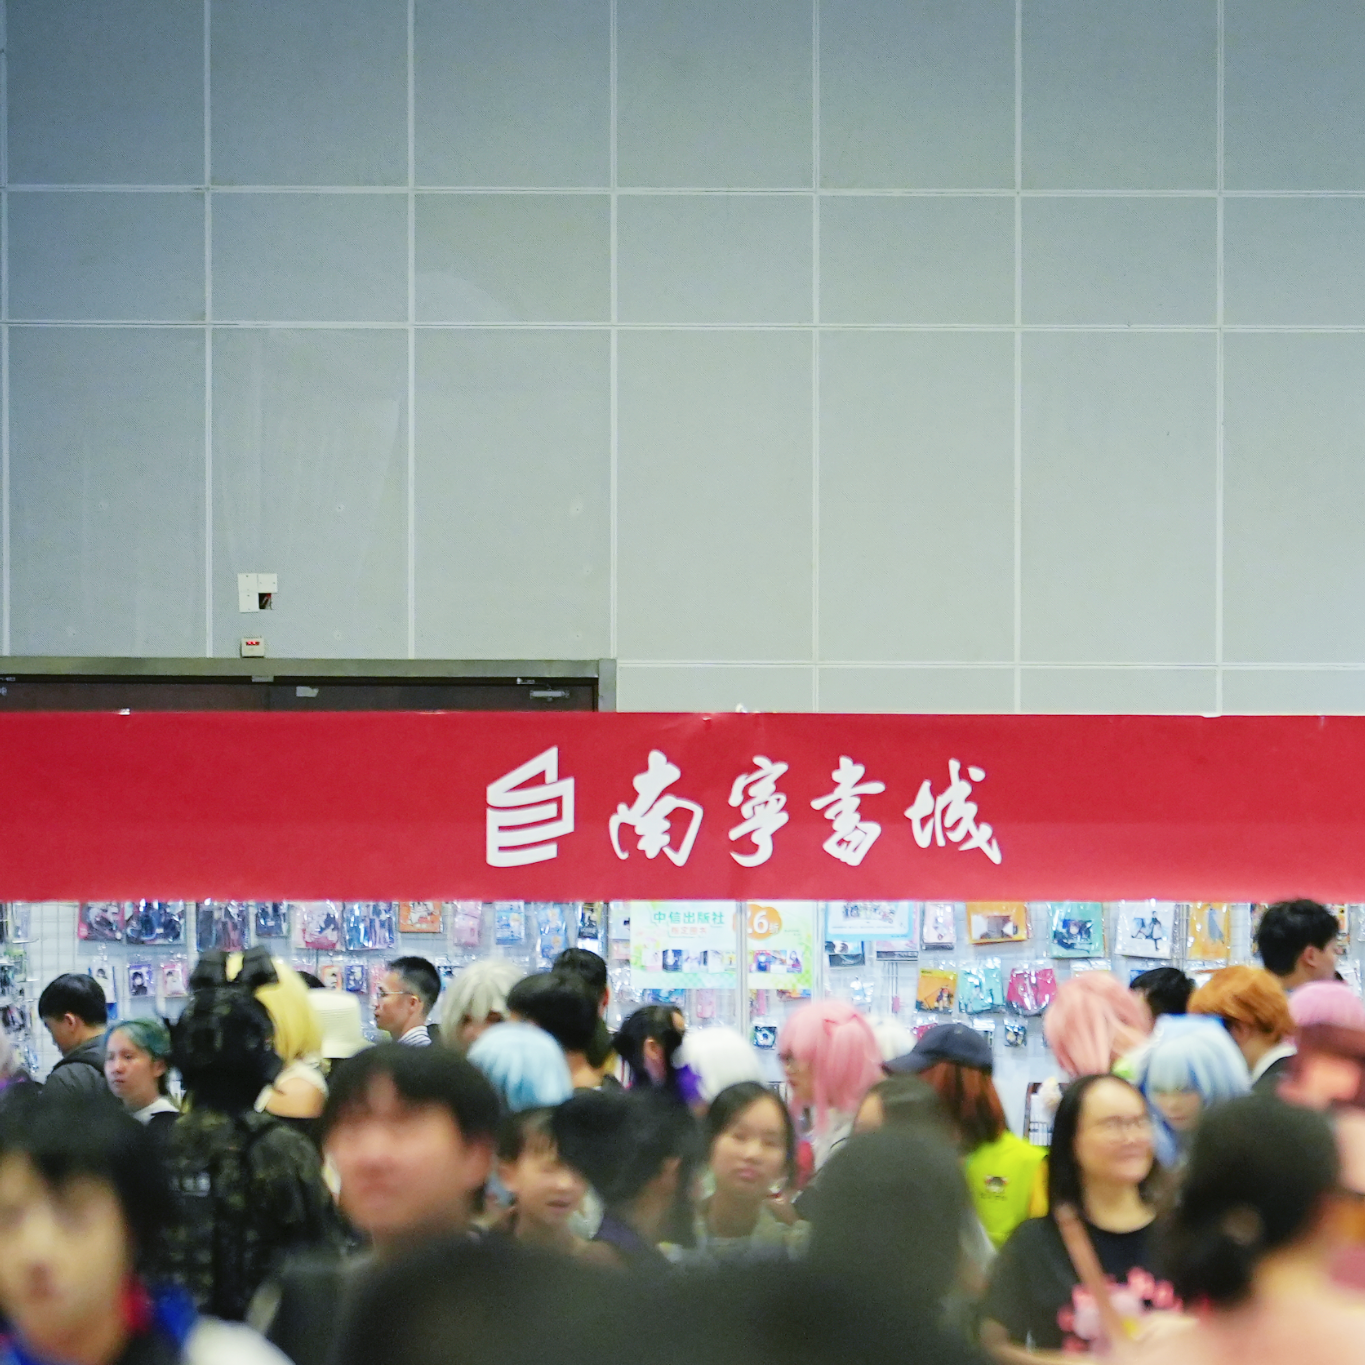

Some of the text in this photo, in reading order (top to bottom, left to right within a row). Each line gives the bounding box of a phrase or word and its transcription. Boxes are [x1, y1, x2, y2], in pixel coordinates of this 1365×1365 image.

[653, 911, 725, 925] 中信出版社
